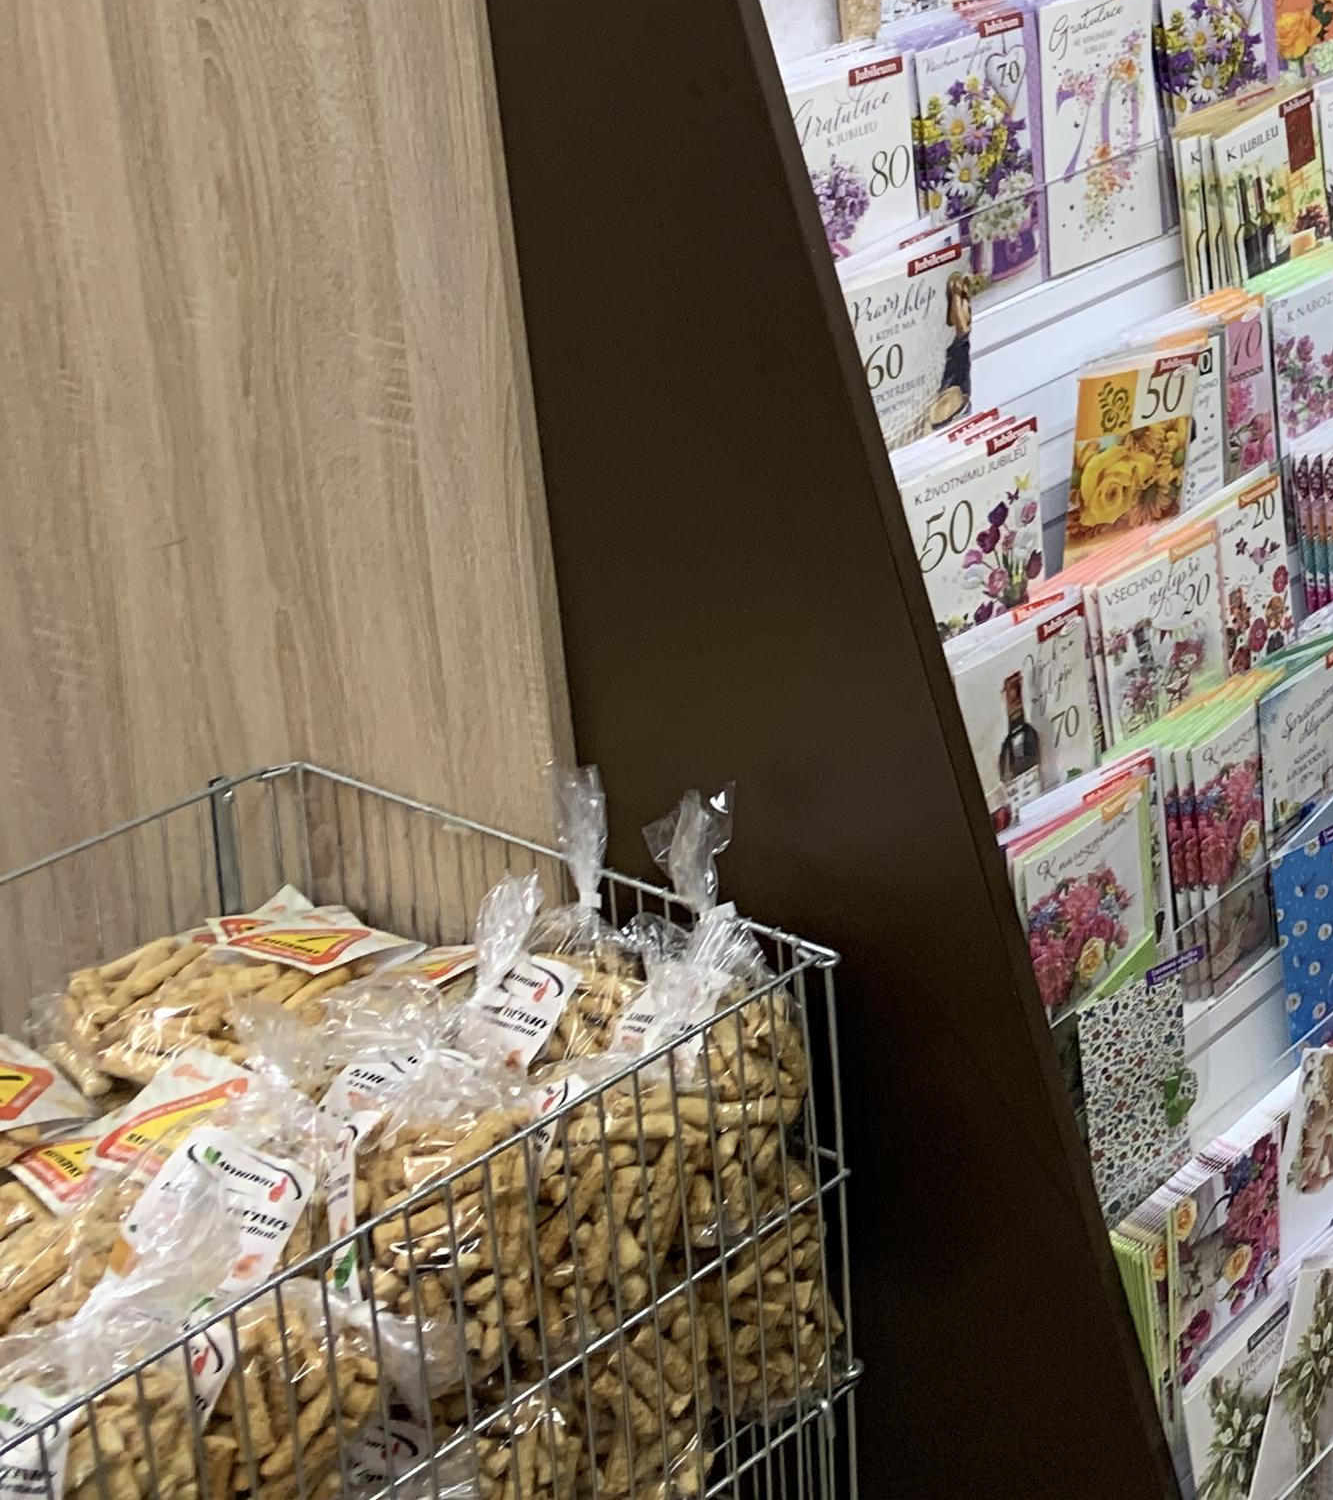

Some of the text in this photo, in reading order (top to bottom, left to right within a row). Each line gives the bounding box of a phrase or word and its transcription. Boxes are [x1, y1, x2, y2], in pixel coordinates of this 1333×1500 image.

[996, 60, 1021, 89] 70
[1226, 125, 1280, 162] K JUBILEU
[869, 144, 910, 198] 80
[865, 343, 904, 390] 60
[1141, 371, 1186, 419] 50
[914, 494, 923, 507] K
[1250, 493, 1276, 530] 20
[920, 500, 974, 574] 50
[1104, 567, 1164, 607] VŠECHNO
[1181, 573, 1211, 617] 20
[1050, 705, 1080, 749] 70
